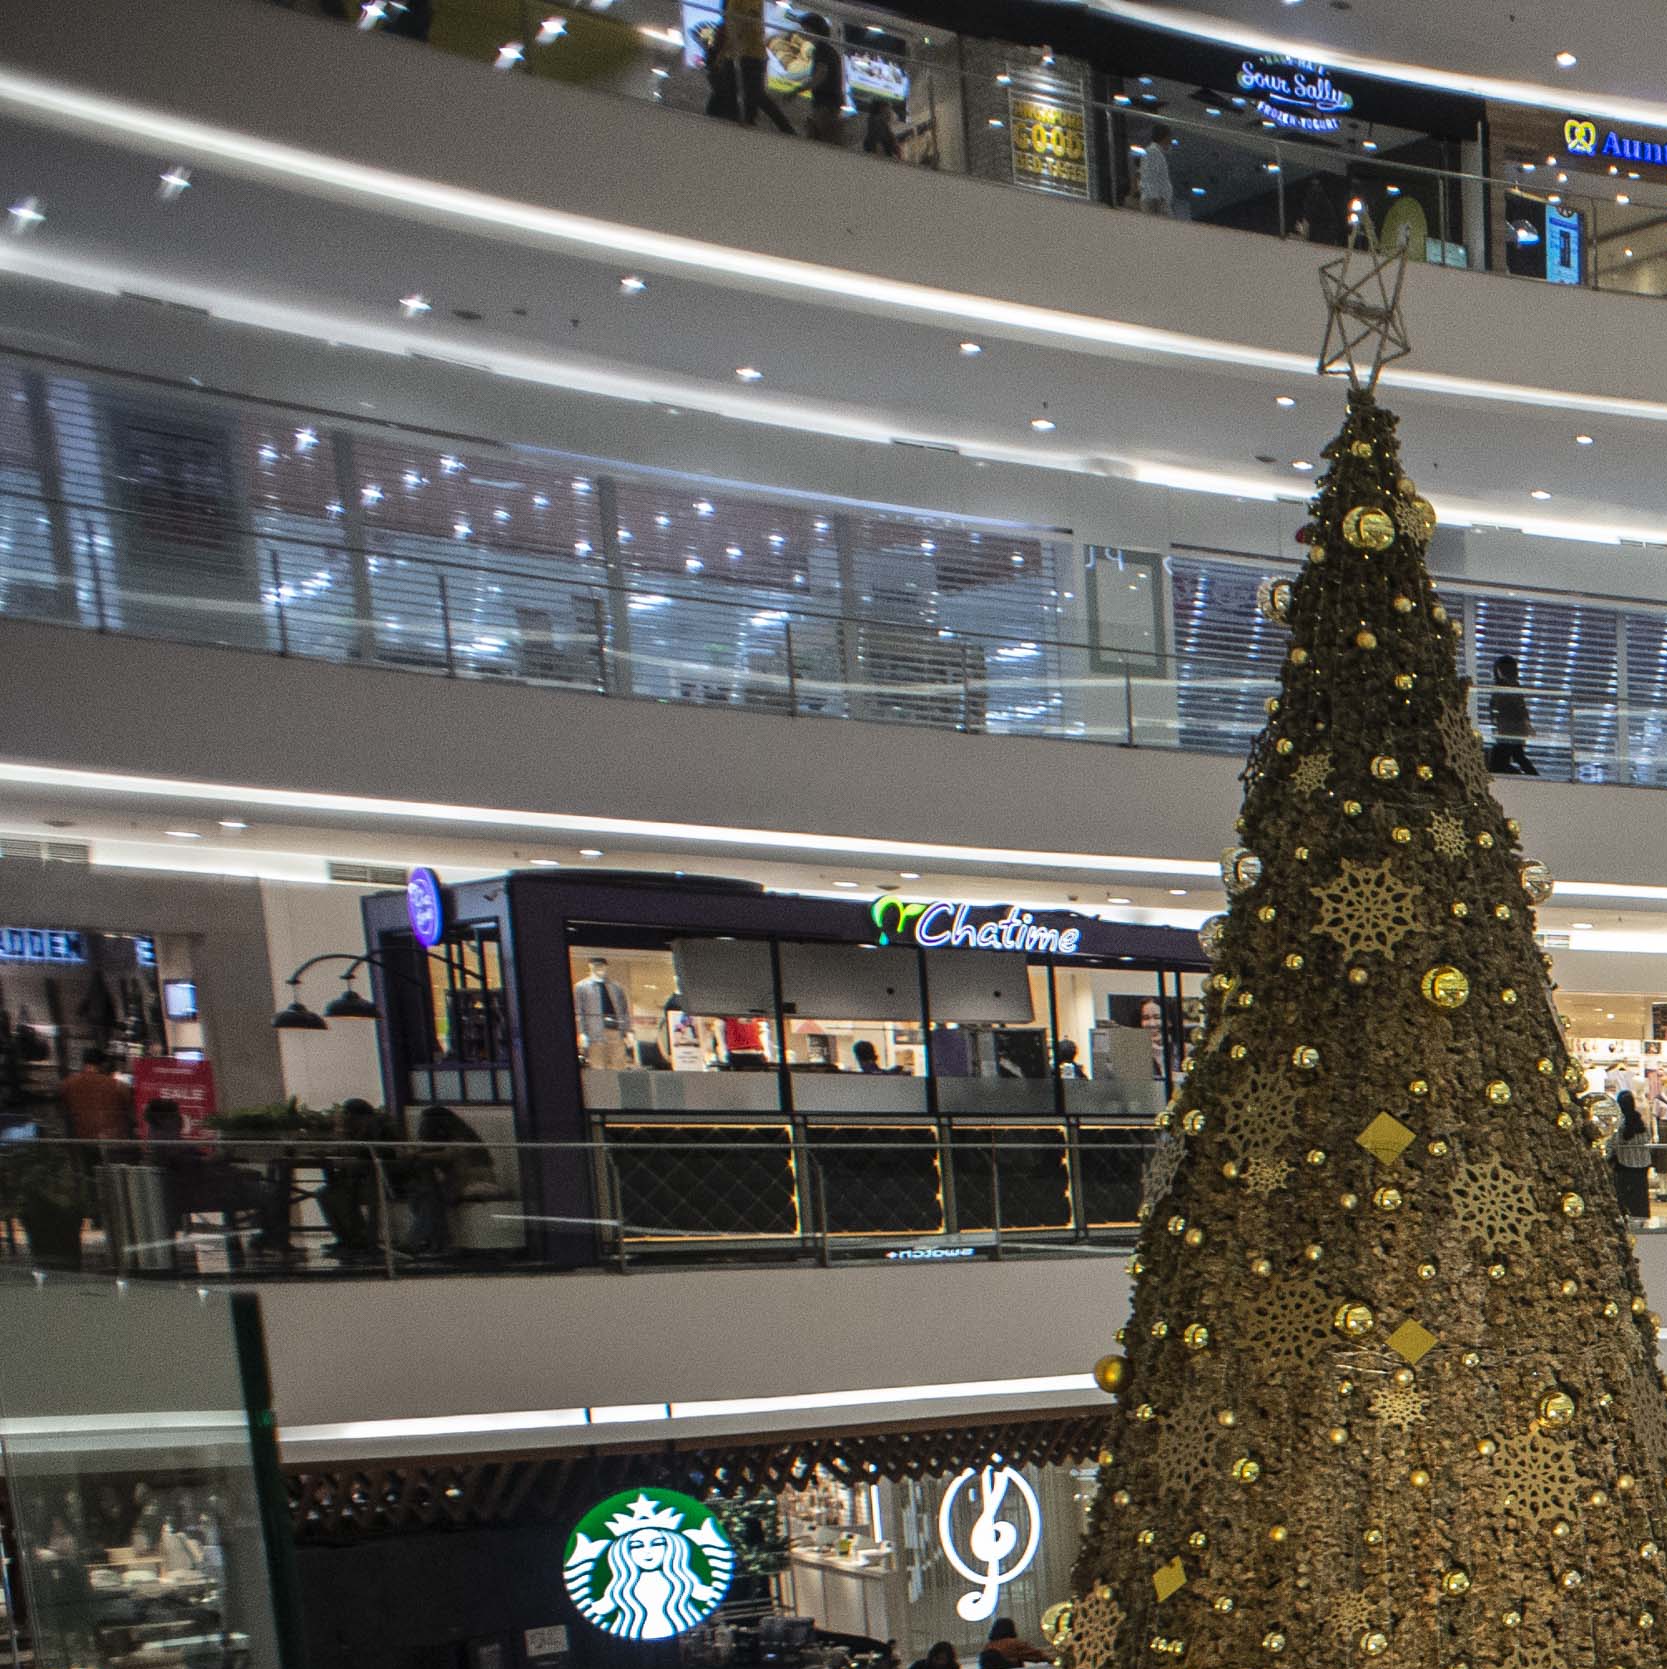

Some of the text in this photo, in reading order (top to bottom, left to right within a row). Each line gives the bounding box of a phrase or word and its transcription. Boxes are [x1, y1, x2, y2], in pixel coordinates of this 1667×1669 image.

[1240, 61, 1291, 95] Sour
[1294, 73, 1349, 112] Sally
[915, 902, 1082, 954] Chatime
